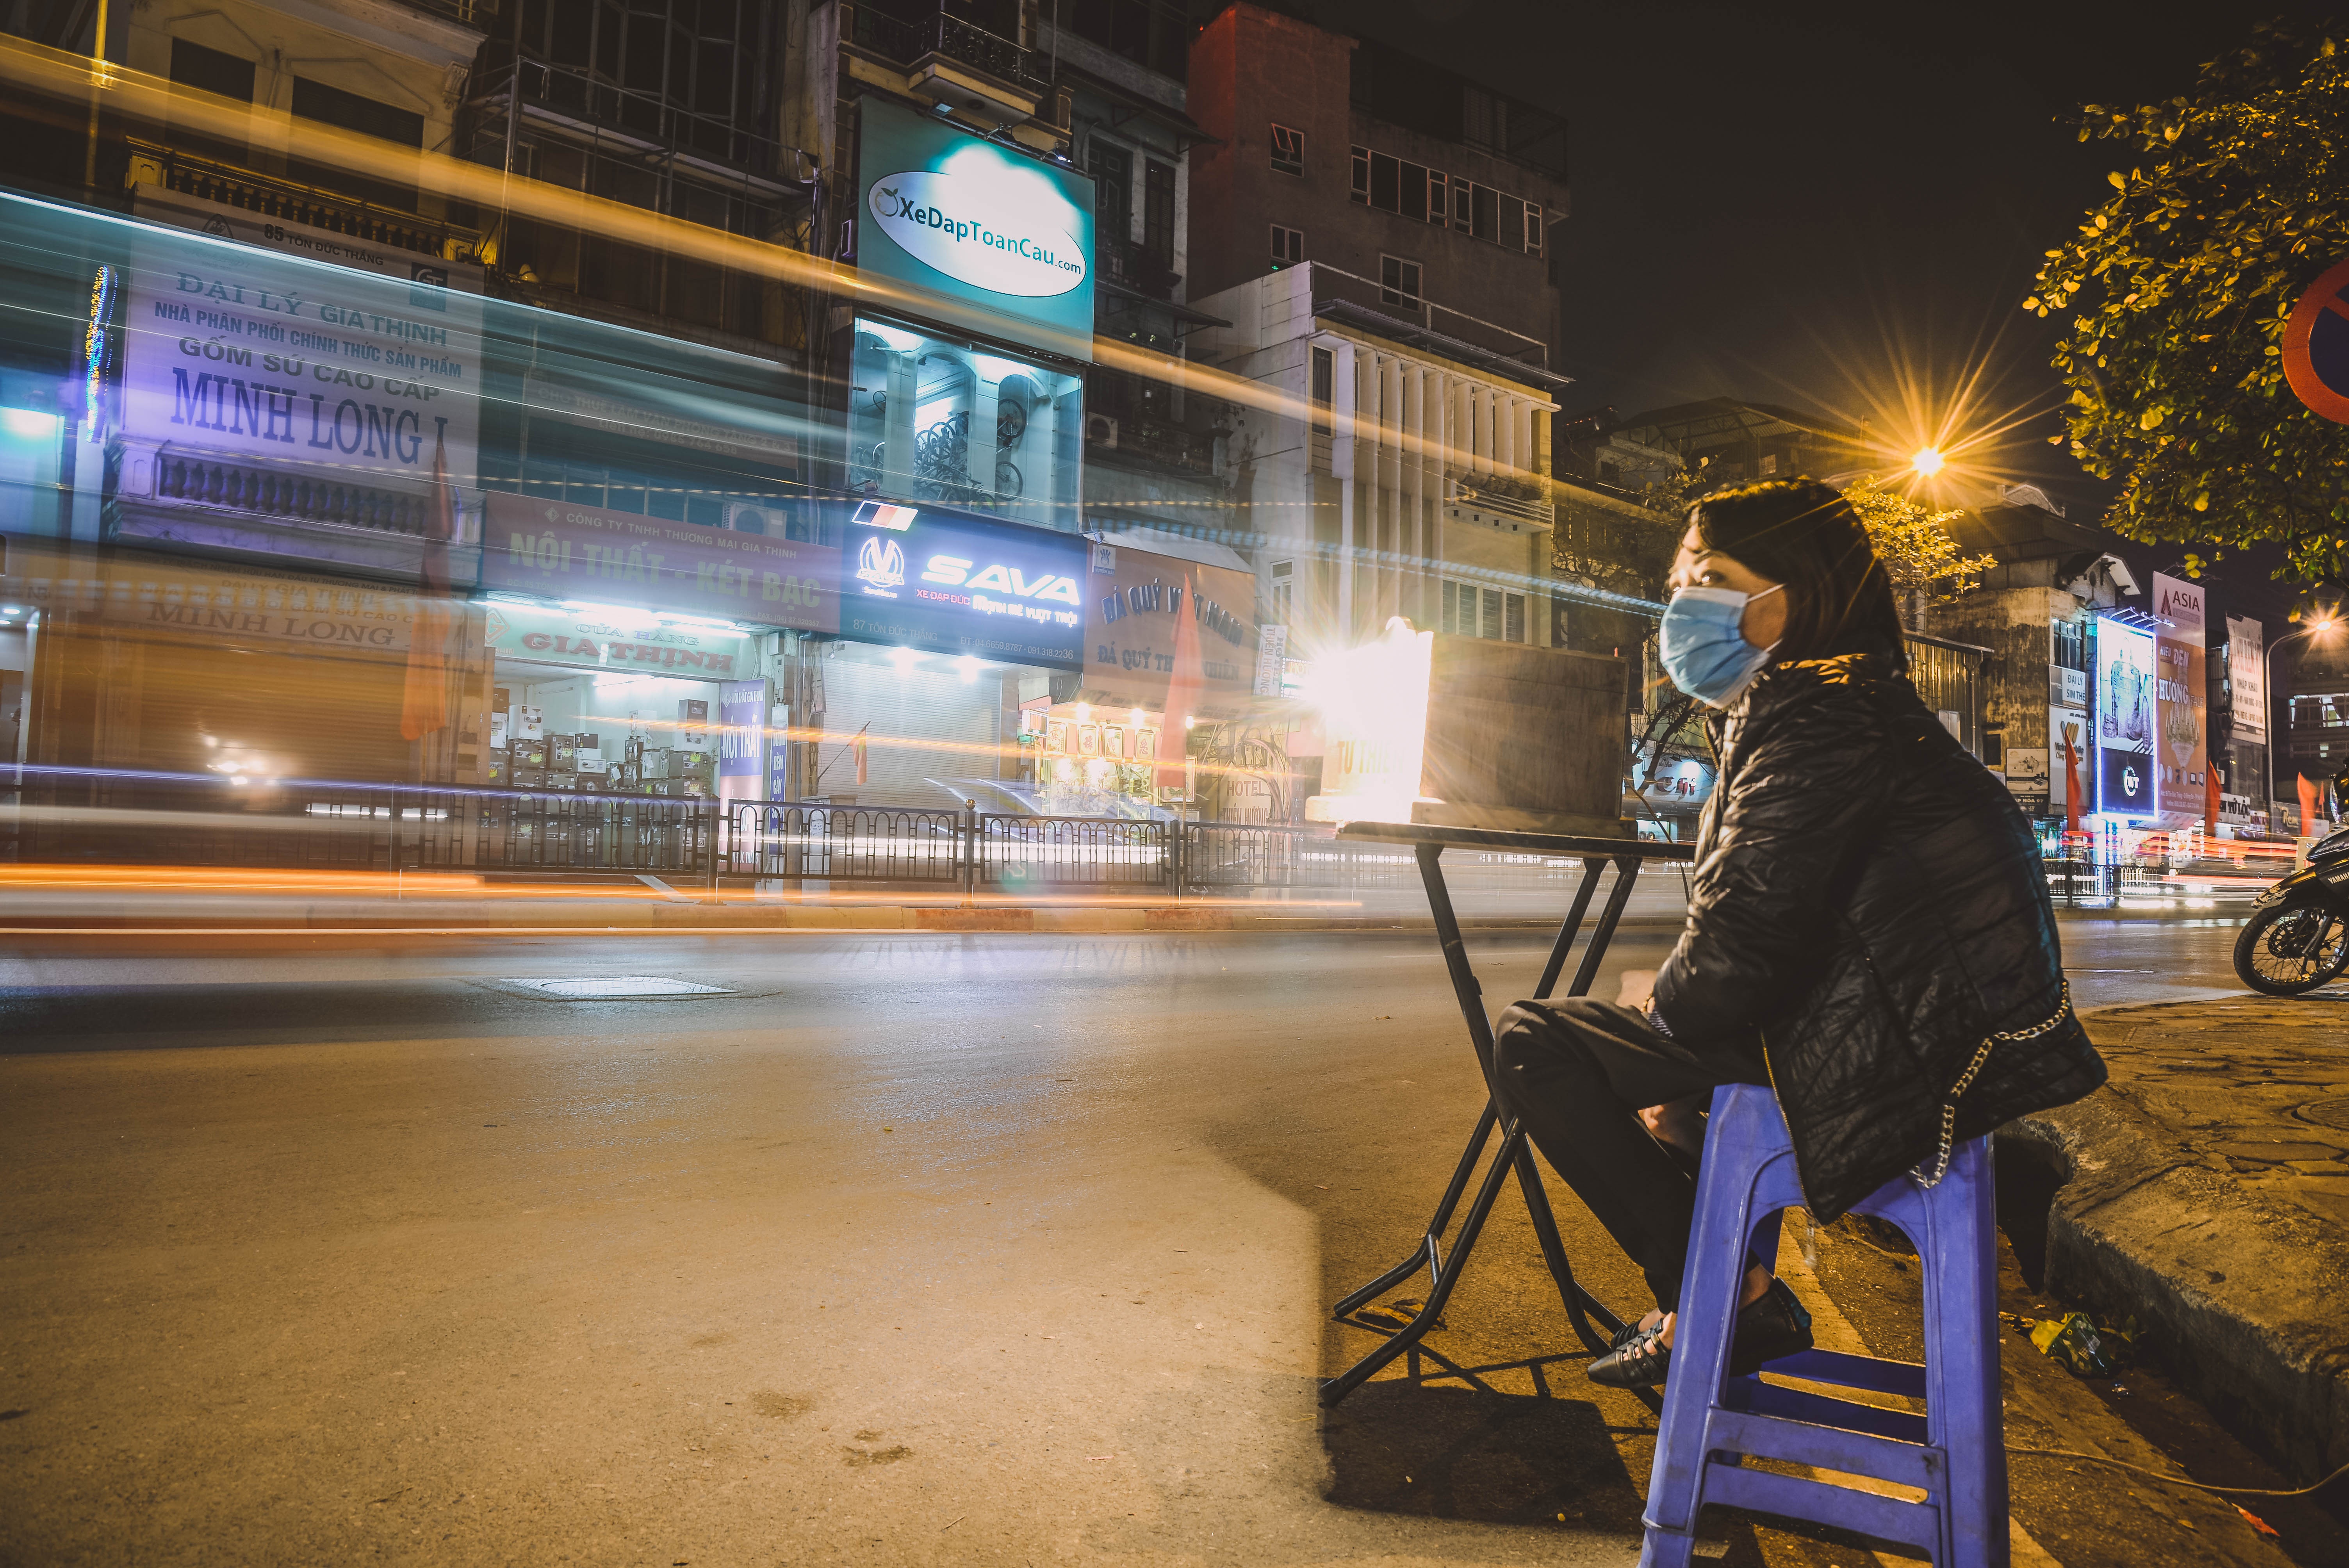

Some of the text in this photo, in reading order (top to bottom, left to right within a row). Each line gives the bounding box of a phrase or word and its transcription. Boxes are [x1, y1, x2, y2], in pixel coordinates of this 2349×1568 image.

[264, 223, 383, 265] 85 TÔN ĐỨC THẮNG
[899, 196, 1081, 274] XeDapToanCau.com
[176, 272, 447, 347] ĐẠI LÝ GIA THỊNH
[155, 301, 462, 378] NHÀ PHÂN PHỐI CHÍNH THỨC SẢN PHẨM
[179, 335, 440, 401] GỐM SỨ CAO CẤP
[171, 367, 297, 444] MINH
[308, 393, 422, 465] LONG
[566, 513, 797, 559] CÔNG TY TNHH THƯƠNG MẠI GIA THỊNH
[509, 531, 572, 577] NỘI
[583, 542, 665, 584] THẤT
[696, 559, 754, 597] KÉT
[762, 571, 820, 611] BẠC
[860, 570, 902, 583] SAVA
[921, 554, 1080, 606] SAVA
[916, 589, 929, 598] XE
[930, 591, 950, 602] ĐẠP
[950, 595, 970, 605] ĐỨC
[1101, 585, 1128, 625] ĐÁ
[1128, 577, 1162, 617] QUÝ
[2173, 590, 2200, 612] ASIA
[147, 602, 273, 633] MINH
[281, 617, 396, 645] LONG
[576, 623, 699, 646] CỬA HÀNG
[757, 612, 773, 620] FAX:
[774, 614, 787, 623] (04)
[797, 617, 819, 627] 320357
[853, 619, 937, 640] 87 TÔN ĐỨC THẮNG
[524, 632, 733, 670] GIA THỊNH
[1028, 646, 1073, 659] 091.318.2236
[739, 688, 747, 703] THẤT
[754, 690, 764, 704] THỊNH
[2066, 689, 2075, 699] SIM
[2068, 674, 2076, 687] ĐẠI
[2078, 676, 2083, 686] LÝ
[2158, 676, 2189, 705] HƯƠNG
[722, 713, 762, 765] NỘI THẤT
[1227, 780, 1262, 796] HOTEL
